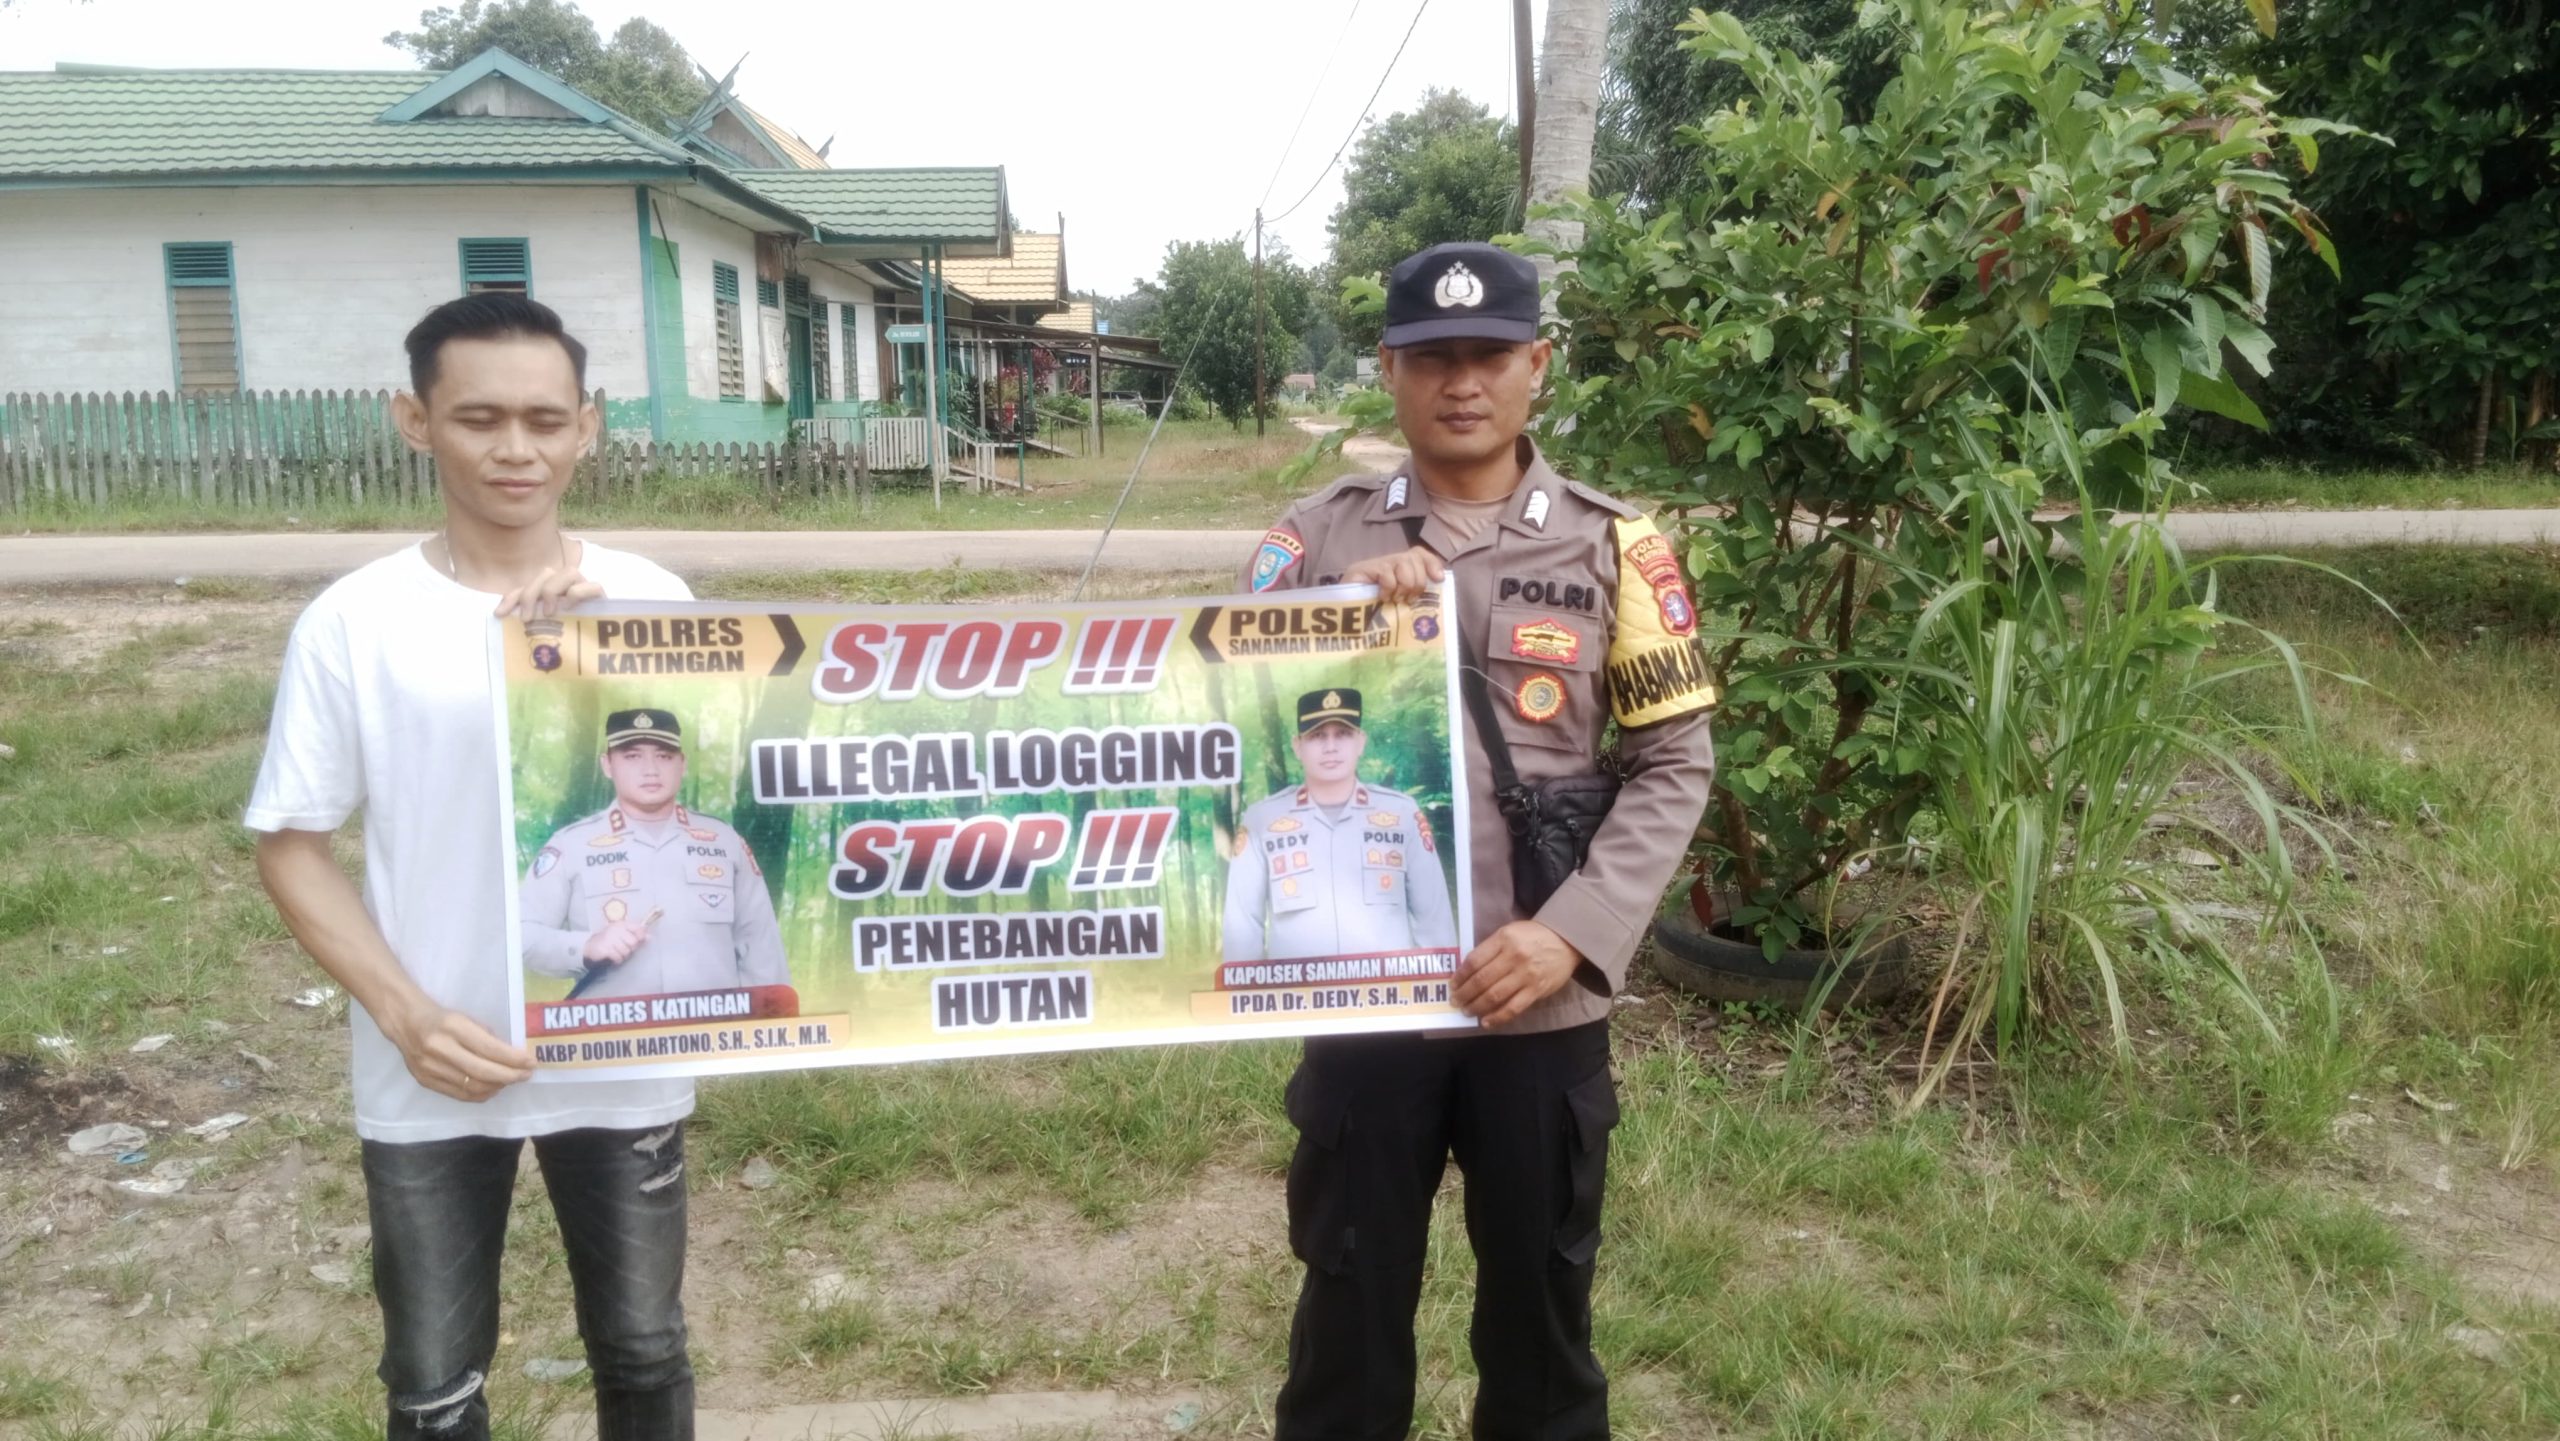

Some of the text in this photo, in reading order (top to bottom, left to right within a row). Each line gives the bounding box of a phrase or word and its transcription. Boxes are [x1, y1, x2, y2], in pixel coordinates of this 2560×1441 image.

[1500, 577, 1595, 611] POLRI
[597, 618, 743, 648] POLRES
[1229, 604, 1390, 637] POLSEK
[820, 617, 1176, 696] STOP !!!
[1229, 635, 1311, 656] SANAMAN
[598, 650, 744, 675] KATINGAN
[758, 728, 1237, 798] ILLEGAL LOGGING
[687, 845, 727, 859] POLRI
[834, 812, 1173, 894] STOP !!!
[1266, 834, 1310, 851] DEDY
[1363, 831, 1404, 845] POLRI
[586, 851, 629, 867] DODIK
[858, 912, 1158, 967] PENEBANGAN
[1224, 953, 1456, 985] KAPOLSEK SANAMAN MANTIKEI
[544, 992, 751, 1030] KAPOLRES KATINGAN
[937, 976, 1089, 1028] HUTAN
[1232, 992, 1277, 1013] IPDA
[1282, 991, 1308, 1010] Dr.
[1312, 987, 1363, 1009] DEDY,
[535, 1044, 577, 1063] AKBP
[582, 1039, 632, 1060] DODIK
[636, 1032, 715, 1057] HARTONO,
[799, 1024, 831, 1044] M.H.
